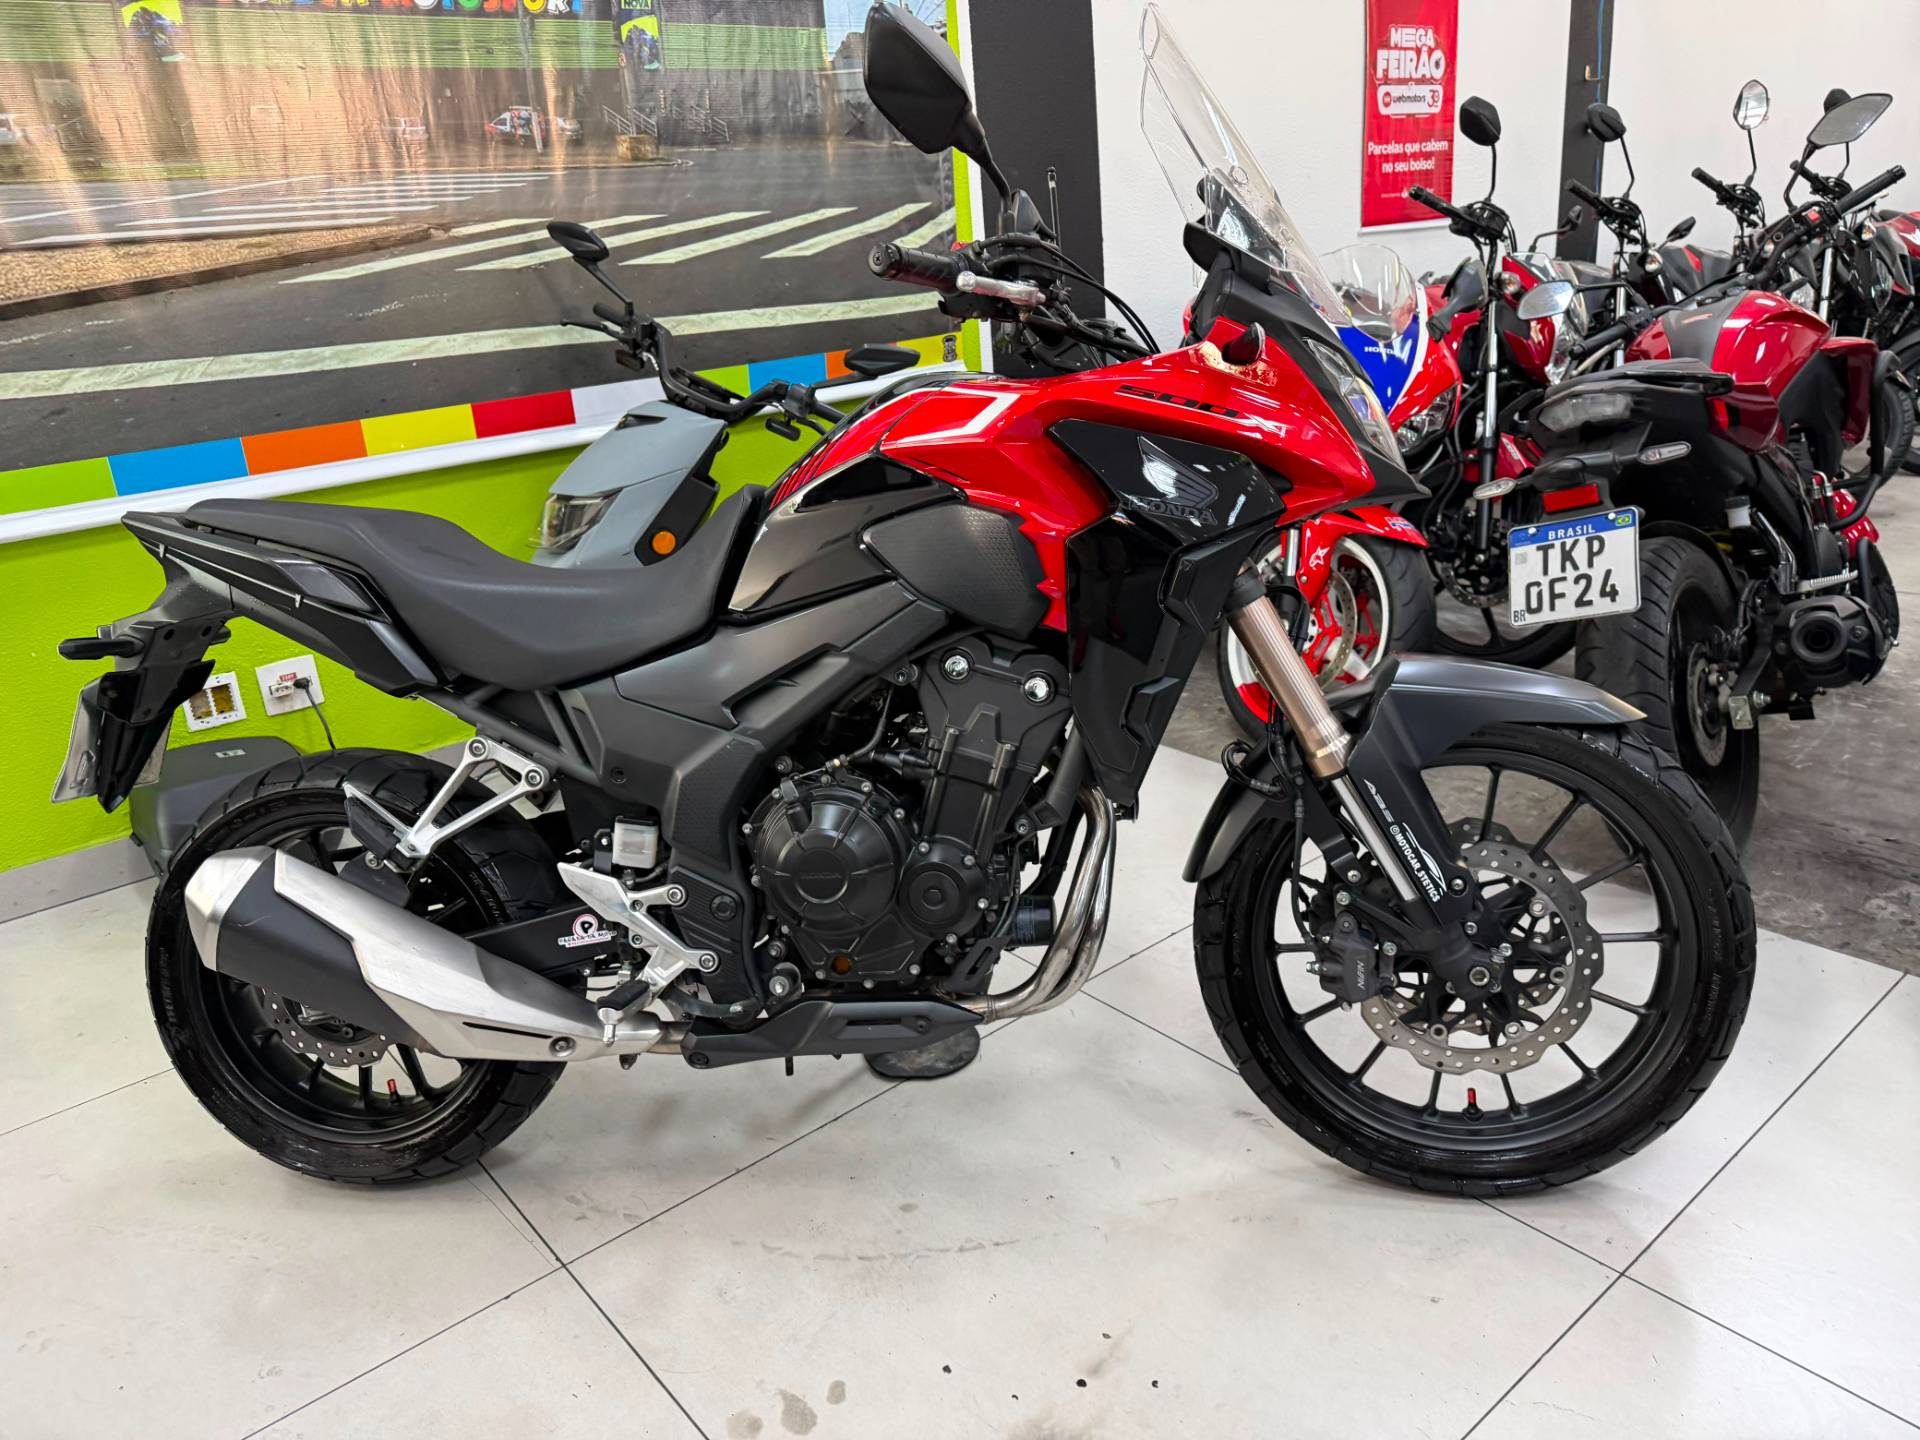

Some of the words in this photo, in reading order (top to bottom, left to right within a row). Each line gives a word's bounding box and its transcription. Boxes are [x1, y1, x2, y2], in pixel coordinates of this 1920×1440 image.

[1390, 27, 1435, 47] MEGA
[1376, 46, 1446, 79] FEIRÃO
[1367, 140, 1404, 155] Parcelas
[1404, 142, 1420, 156] que
[1421, 138, 1449, 152] cabem
[1382, 162, 1393, 173] no
[1394, 162, 1409, 172] seu
[1409, 157, 1435, 171] bolso!
[1120, 498, 1218, 526] HONDA
[1548, 524, 1596, 540] BRASIL
[1536, 535, 1606, 576] TKP
[1513, 609, 1526, 623] BR
